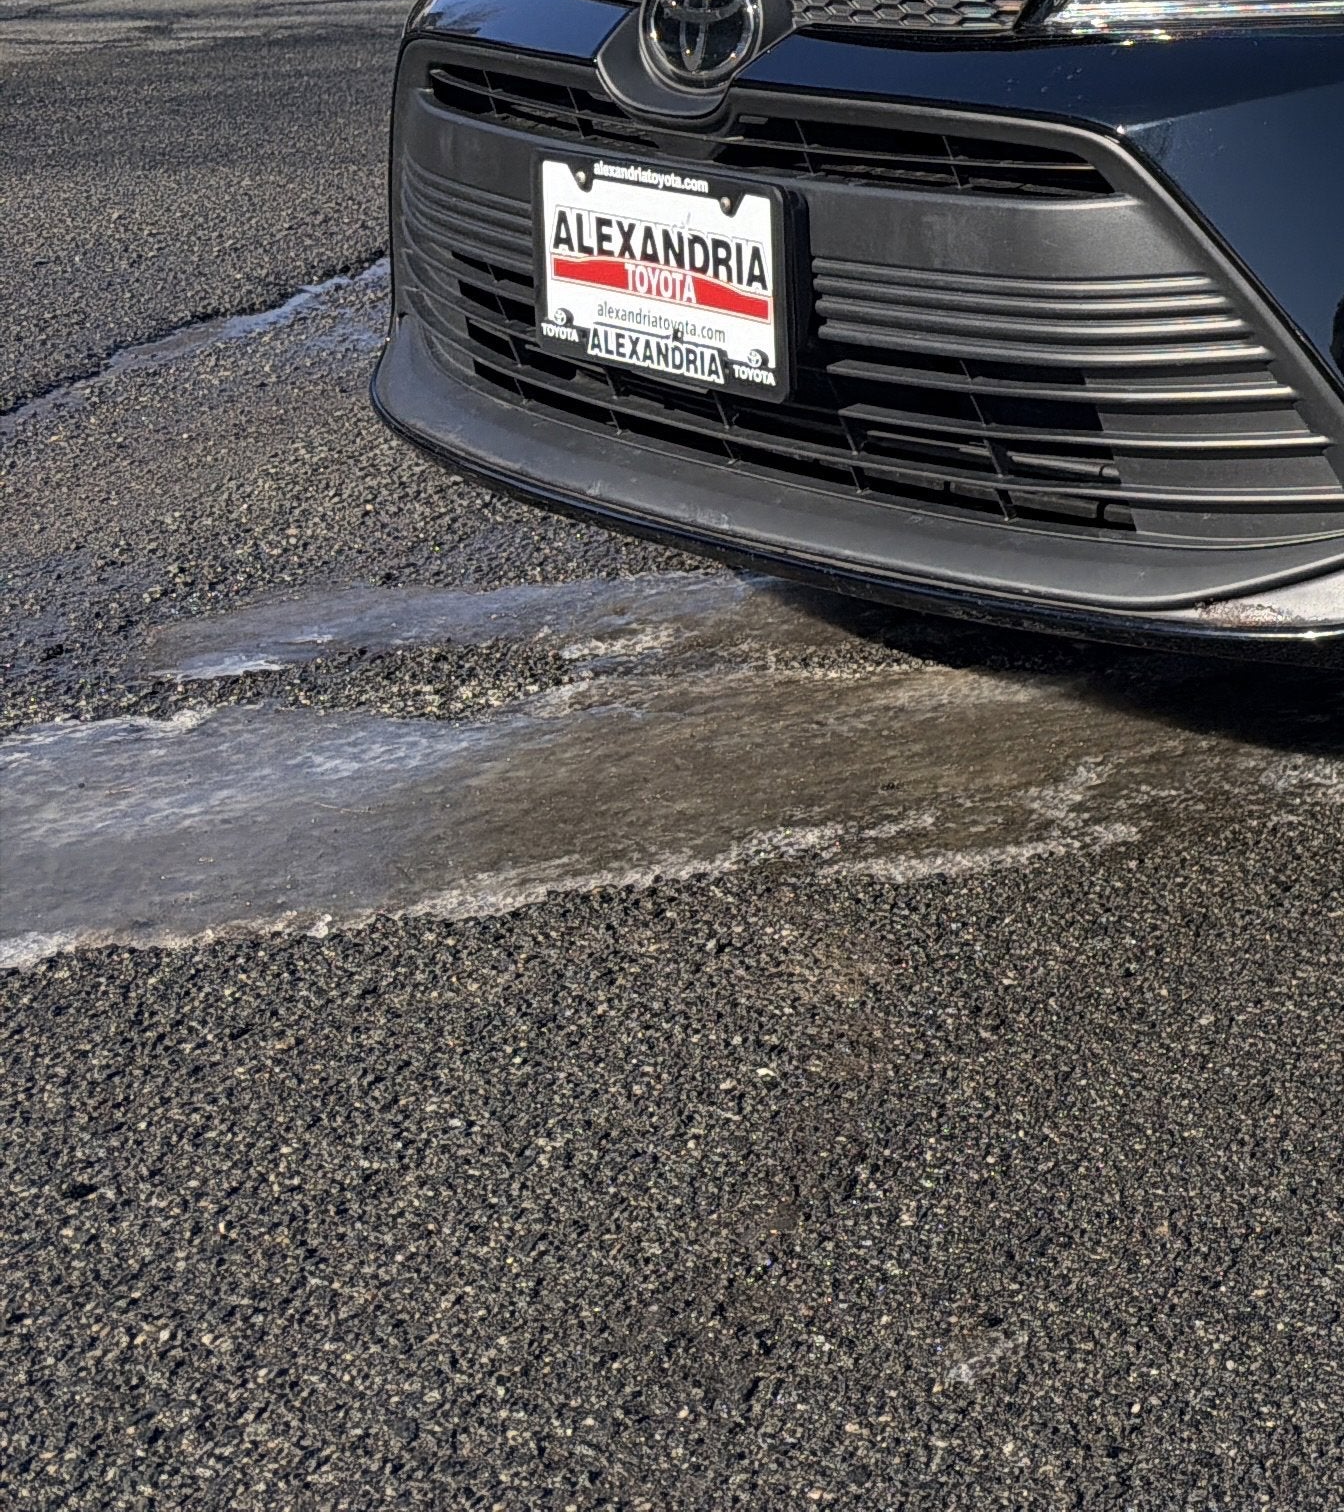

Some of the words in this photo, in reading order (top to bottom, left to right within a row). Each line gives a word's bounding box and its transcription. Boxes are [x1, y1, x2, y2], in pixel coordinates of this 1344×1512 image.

[593, 160, 709, 193] alexandriatoyota.com
[552, 209, 769, 291] ALEXANDRIA
[624, 263, 697, 304] TOYOTA
[541, 322, 579, 342] TOYOTA
[597, 301, 726, 344] alexandriatoyota.com
[589, 326, 724, 384] ALEXANDRIA
[733, 365, 776, 386] TOYOTA
